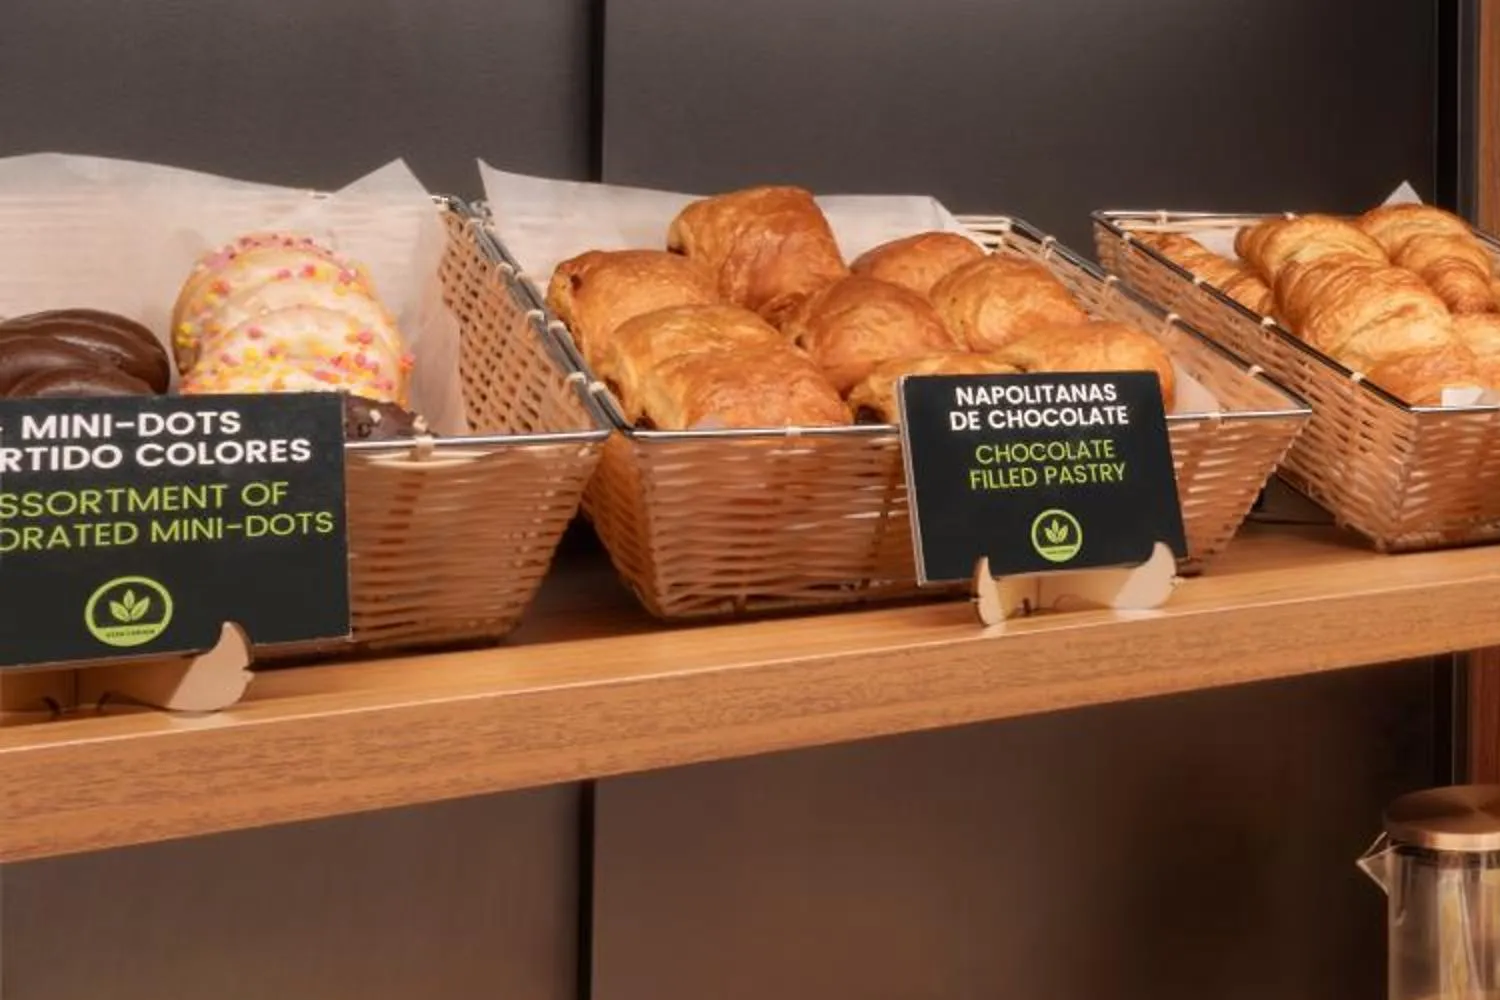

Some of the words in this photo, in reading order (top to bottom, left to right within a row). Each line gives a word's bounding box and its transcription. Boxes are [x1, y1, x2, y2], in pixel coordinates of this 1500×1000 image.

[955, 382, 1117, 406] NAPOLITANAS
[21, 411, 241, 441] MINI-DOTS
[949, 411, 981, 431] DE
[987, 405, 1129, 430] CHOCOLATE
[135, 438, 312, 467] COLORES
[975, 439, 1115, 465] CHOCOLATE
[969, 467, 1038, 490] FILLED
[1043, 462, 1126, 485] PASTRY
[240, 481, 289, 508] OF
[151, 511, 334, 543] MINI-DOTS
